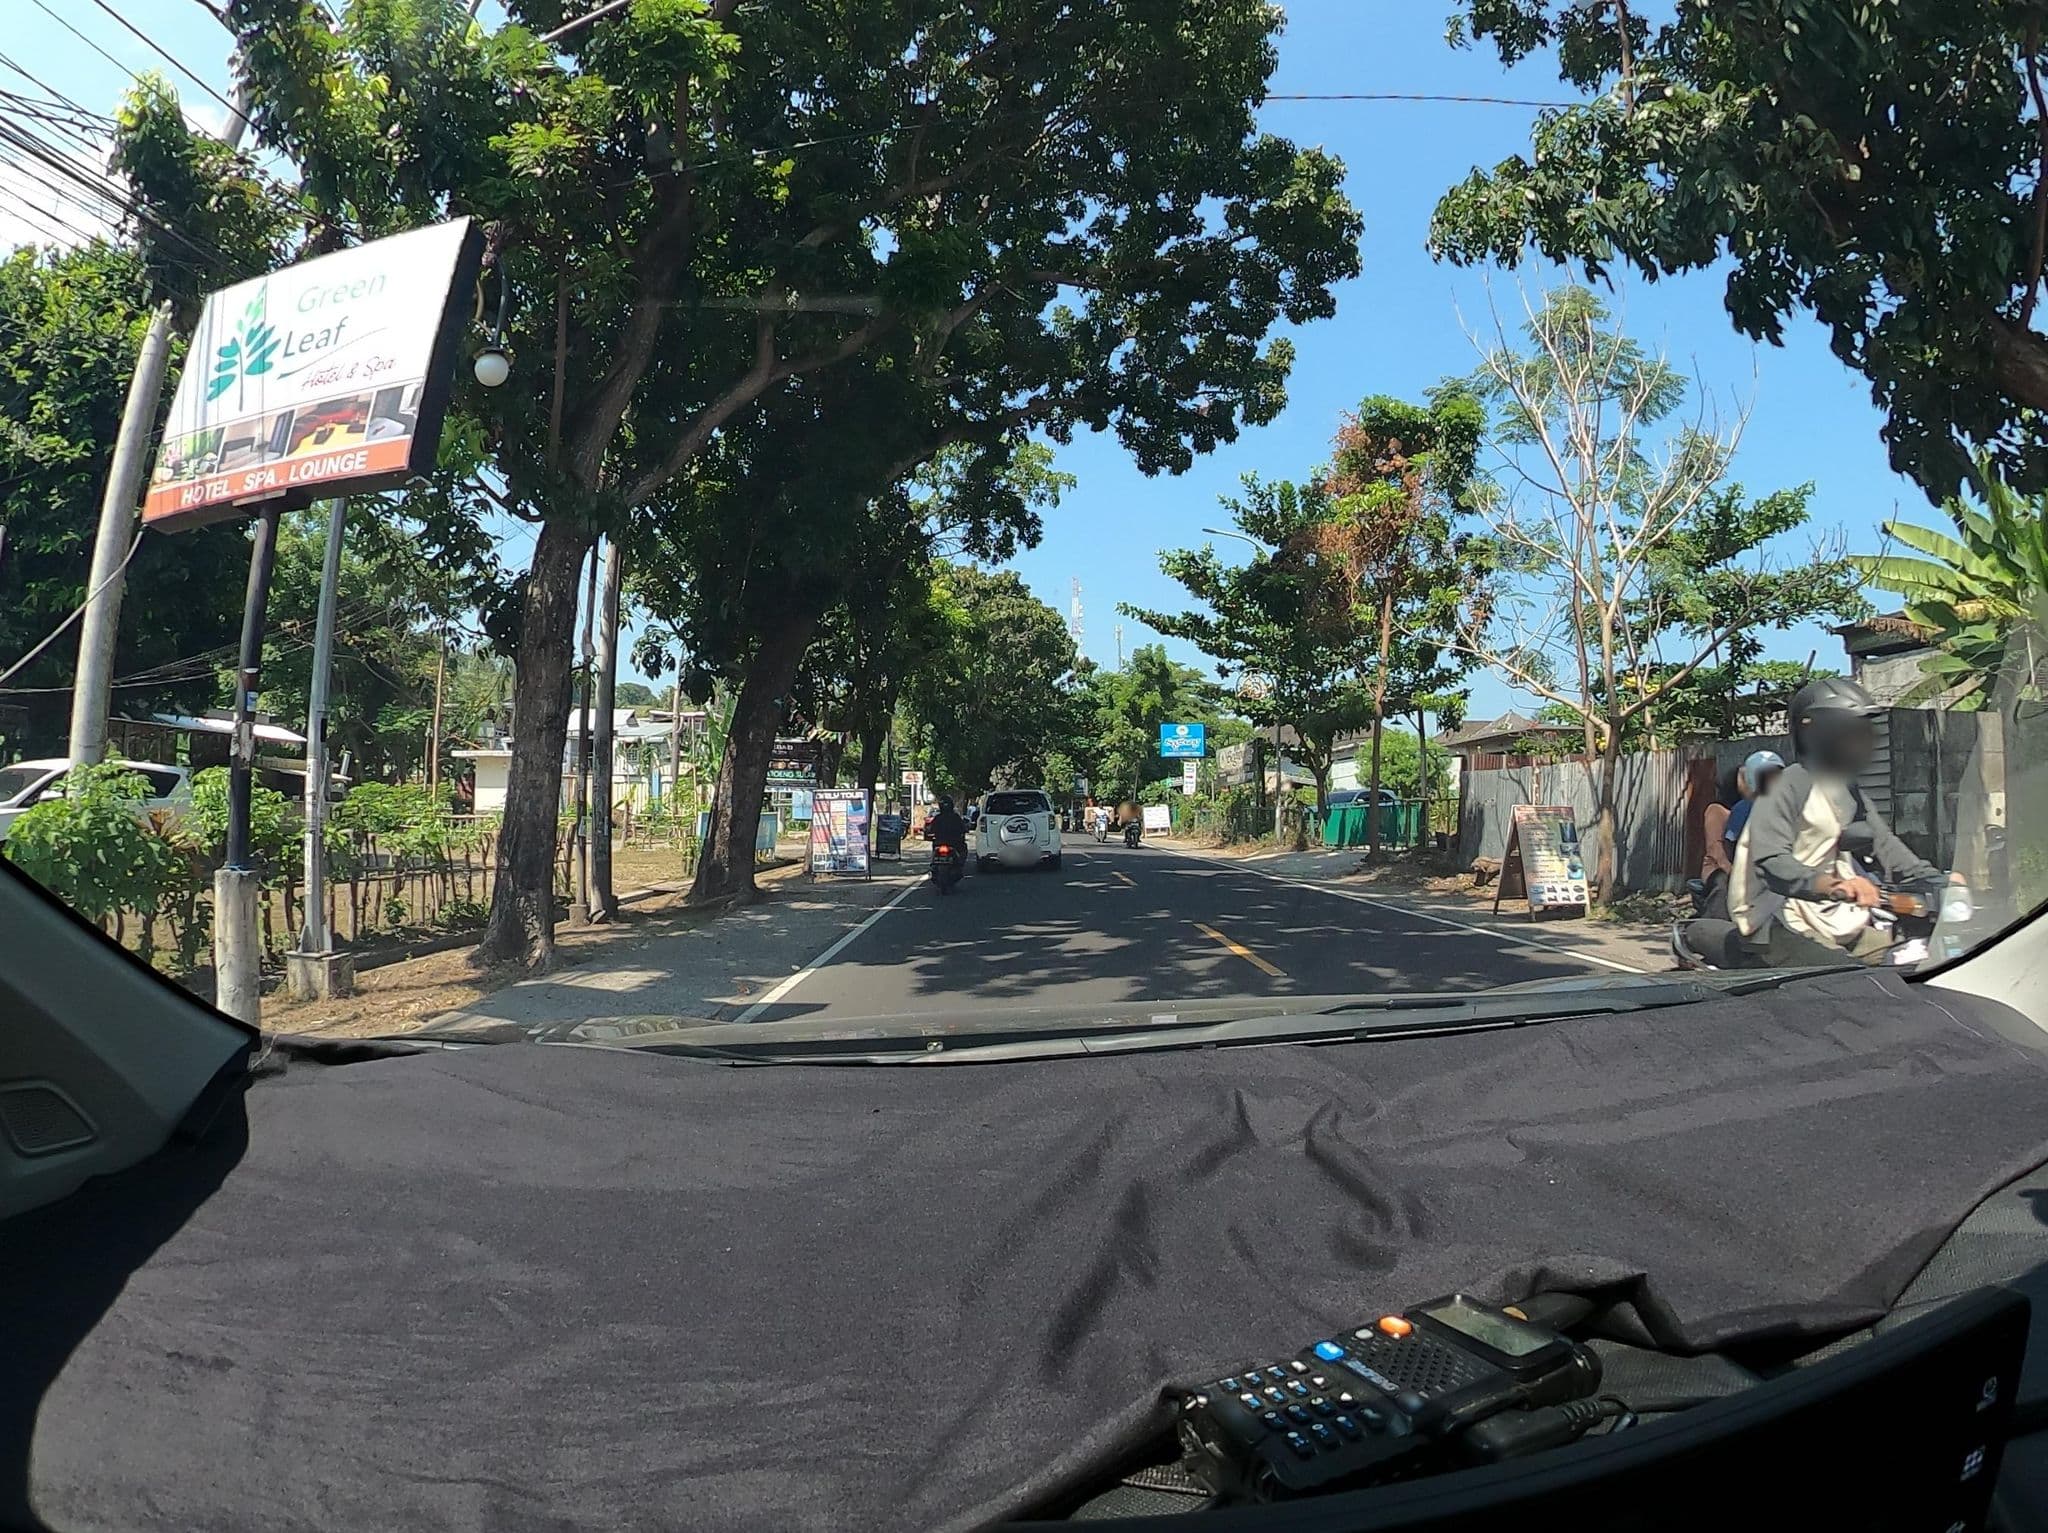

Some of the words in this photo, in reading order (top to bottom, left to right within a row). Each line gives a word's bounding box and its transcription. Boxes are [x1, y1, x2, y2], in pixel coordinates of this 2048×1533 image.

[297, 271, 387, 314] Green
[282, 316, 349, 359] Leaf
[301, 366, 343, 391] Hotel
[363, 356, 397, 380] Spa
[181, 480, 231, 507] HOTEL
[244, 471, 277, 493] SPA
[289, 450, 368, 482] LOUNGE
